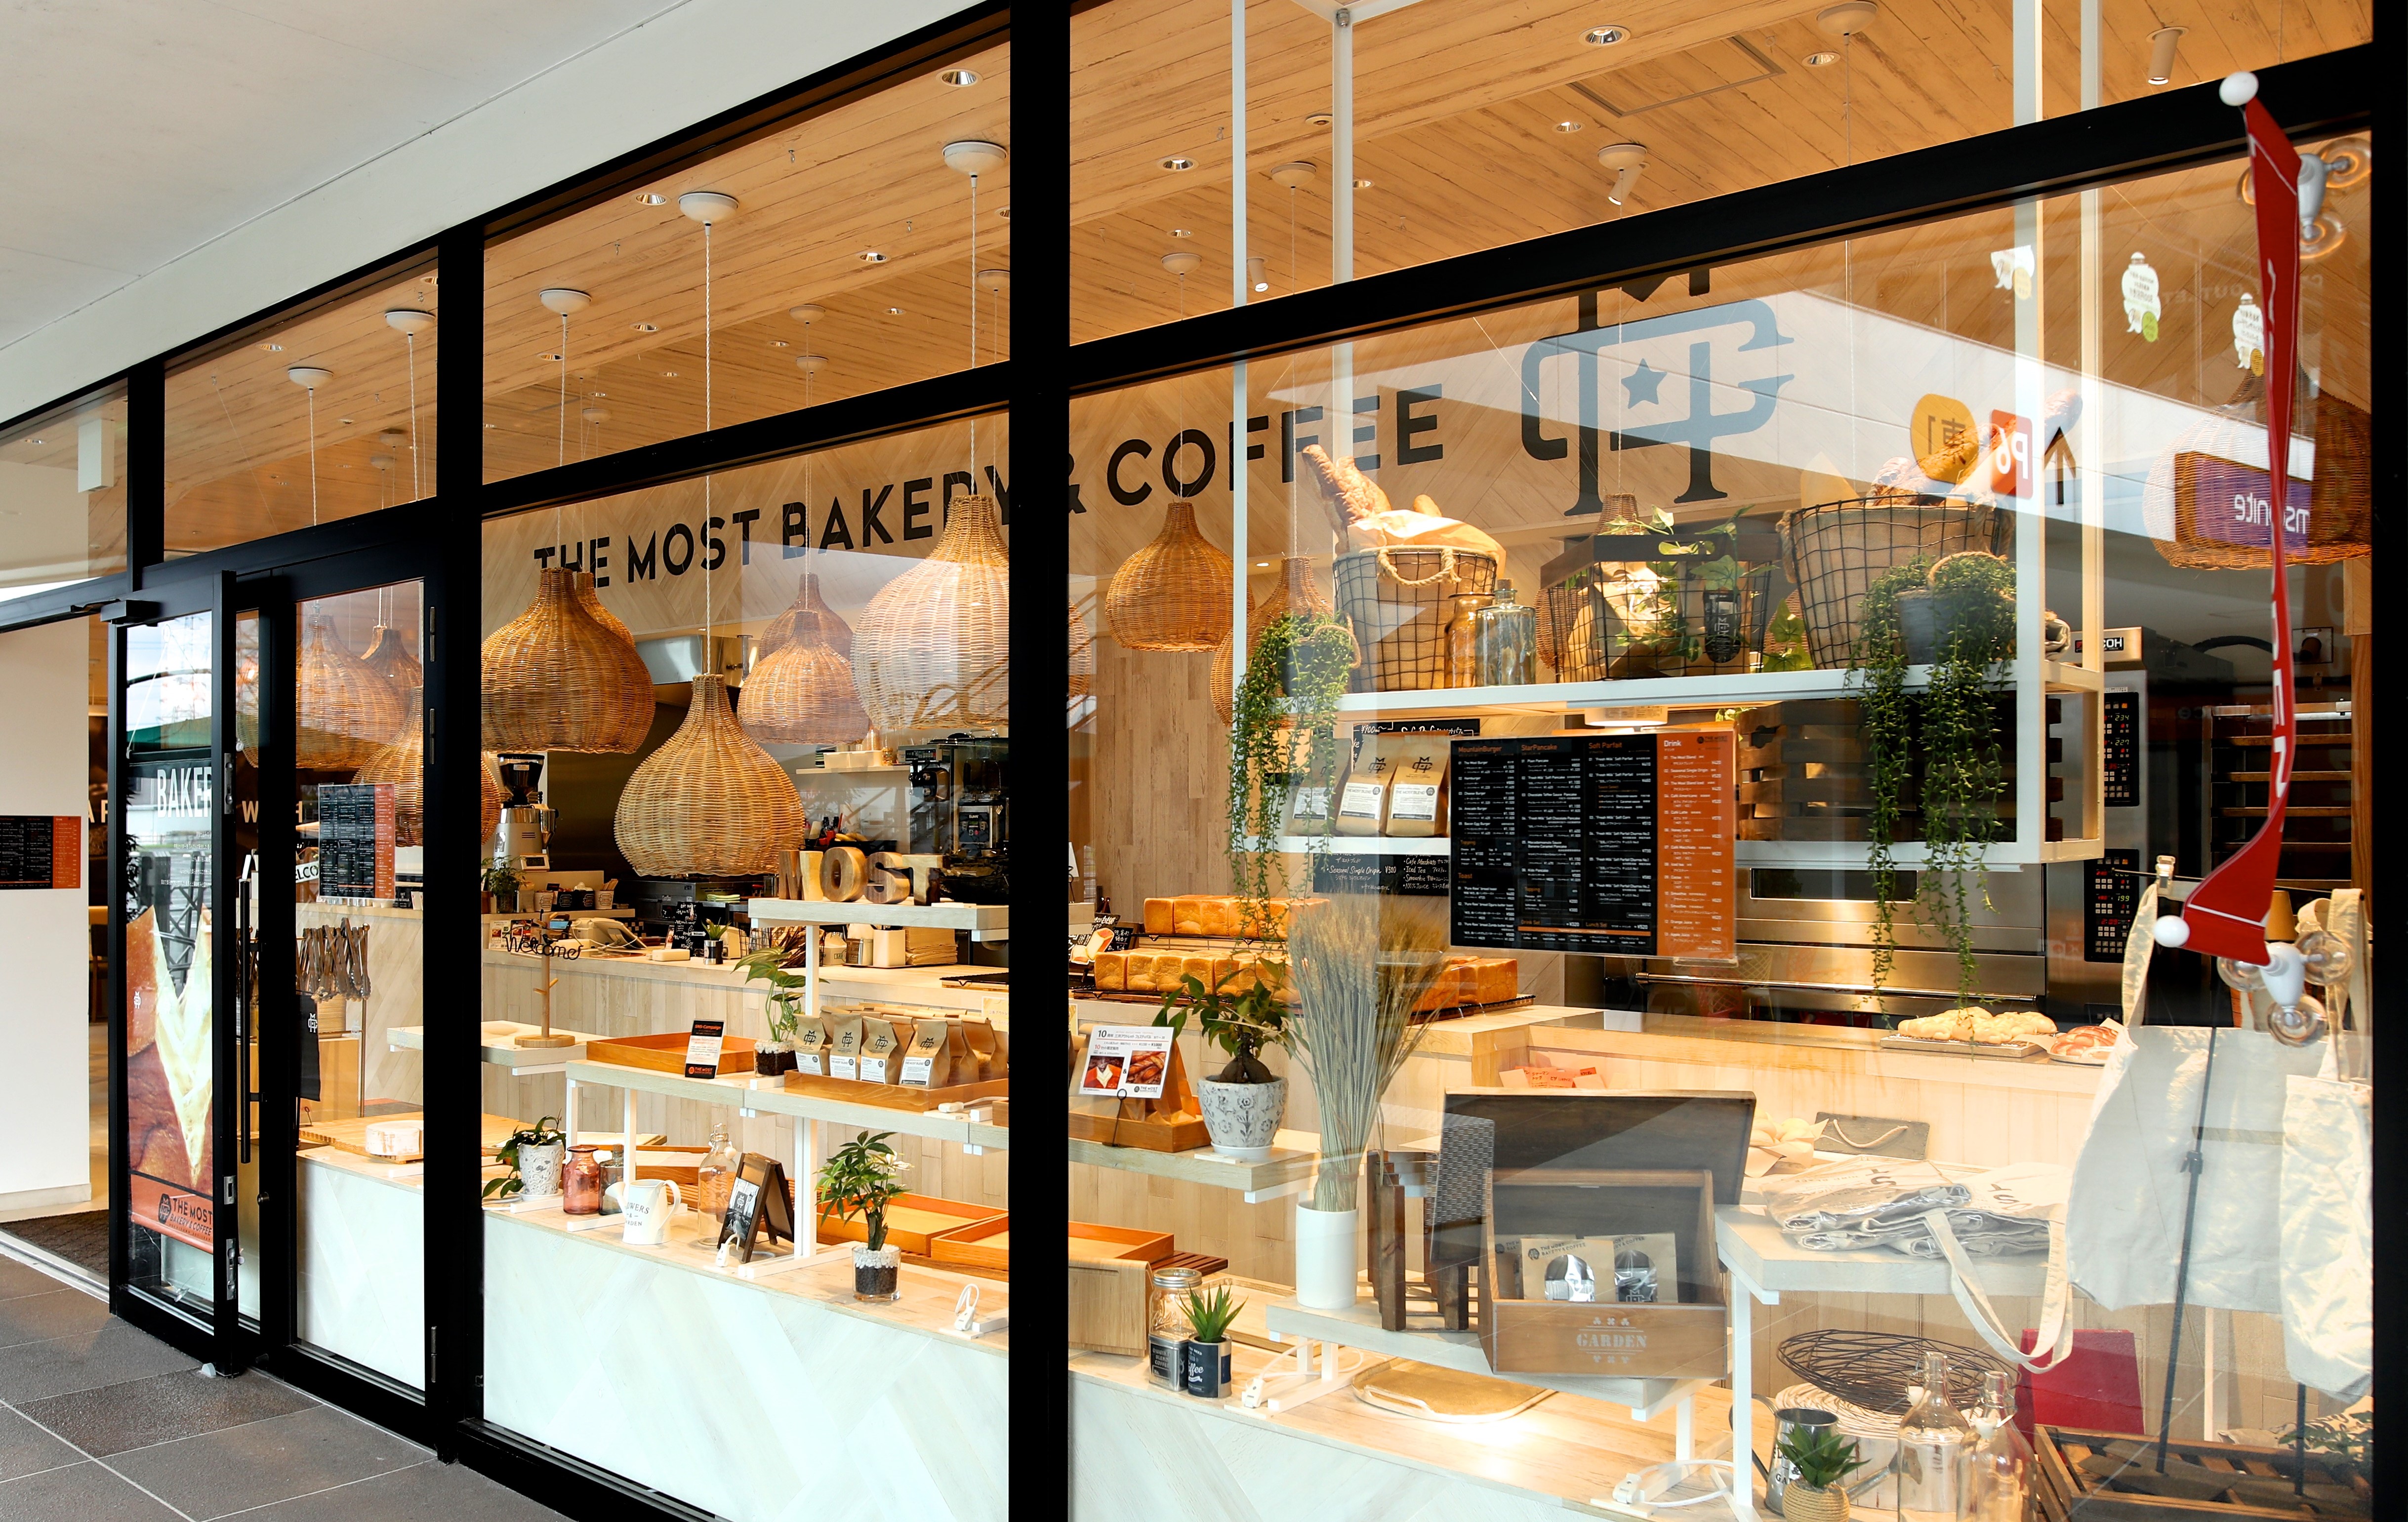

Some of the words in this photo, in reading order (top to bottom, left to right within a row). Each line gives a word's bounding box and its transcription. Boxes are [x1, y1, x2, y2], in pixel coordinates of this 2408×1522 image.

[533, 536, 610, 589] THE
[627, 508, 760, 583] MOST
[1106, 383, 1443, 506] COFFEE
[778, 846, 950, 905] MOST
[1329, 865, 1348, 874] Seasonal
[1350, 865, 1365, 874] Single
[173, 1198, 188, 1216] THE
[190, 1205, 213, 1225] MOST
[169, 1213, 189, 1227] BAKERY
[193, 1222, 212, 1236] COFFEE
[1576, 1335, 1647, 1349] GARDEN
